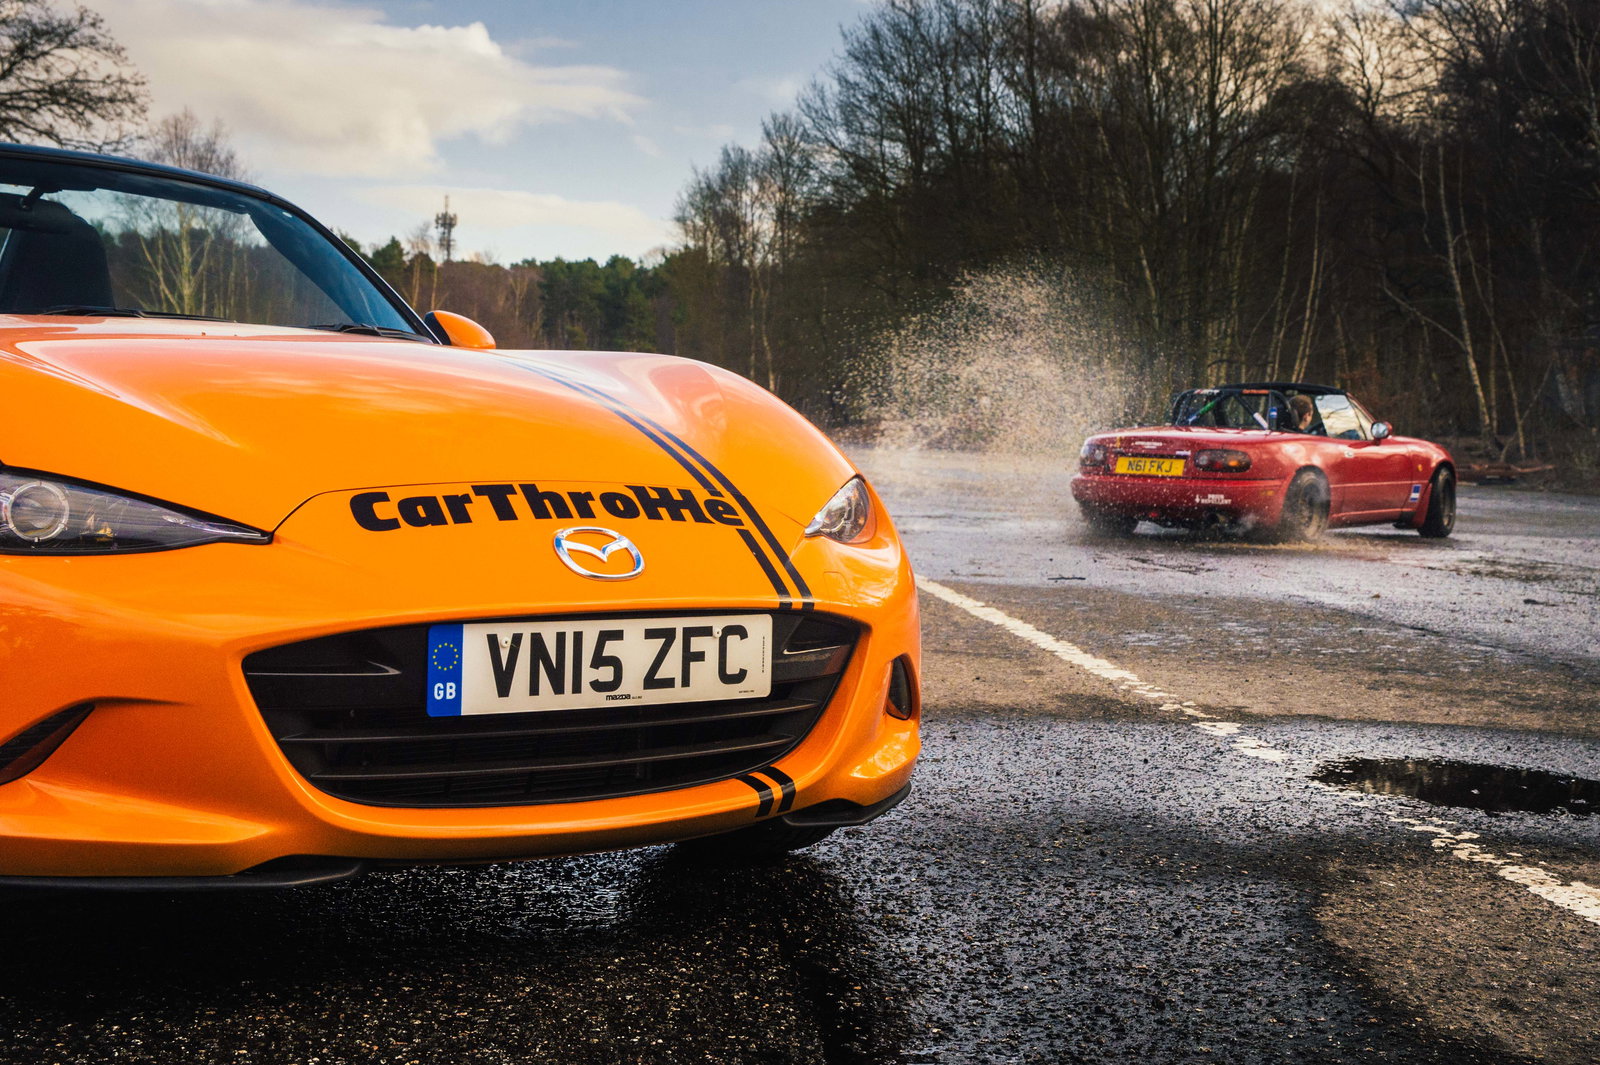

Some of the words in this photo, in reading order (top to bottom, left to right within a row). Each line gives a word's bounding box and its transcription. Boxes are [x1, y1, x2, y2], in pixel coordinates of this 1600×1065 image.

[1127, 460, 1147, 472] N61
[1149, 460, 1174, 473] FKJ
[486, 629, 625, 698] VN15
[642, 624, 749, 691] ZFC
[433, 682, 456, 700] GB
